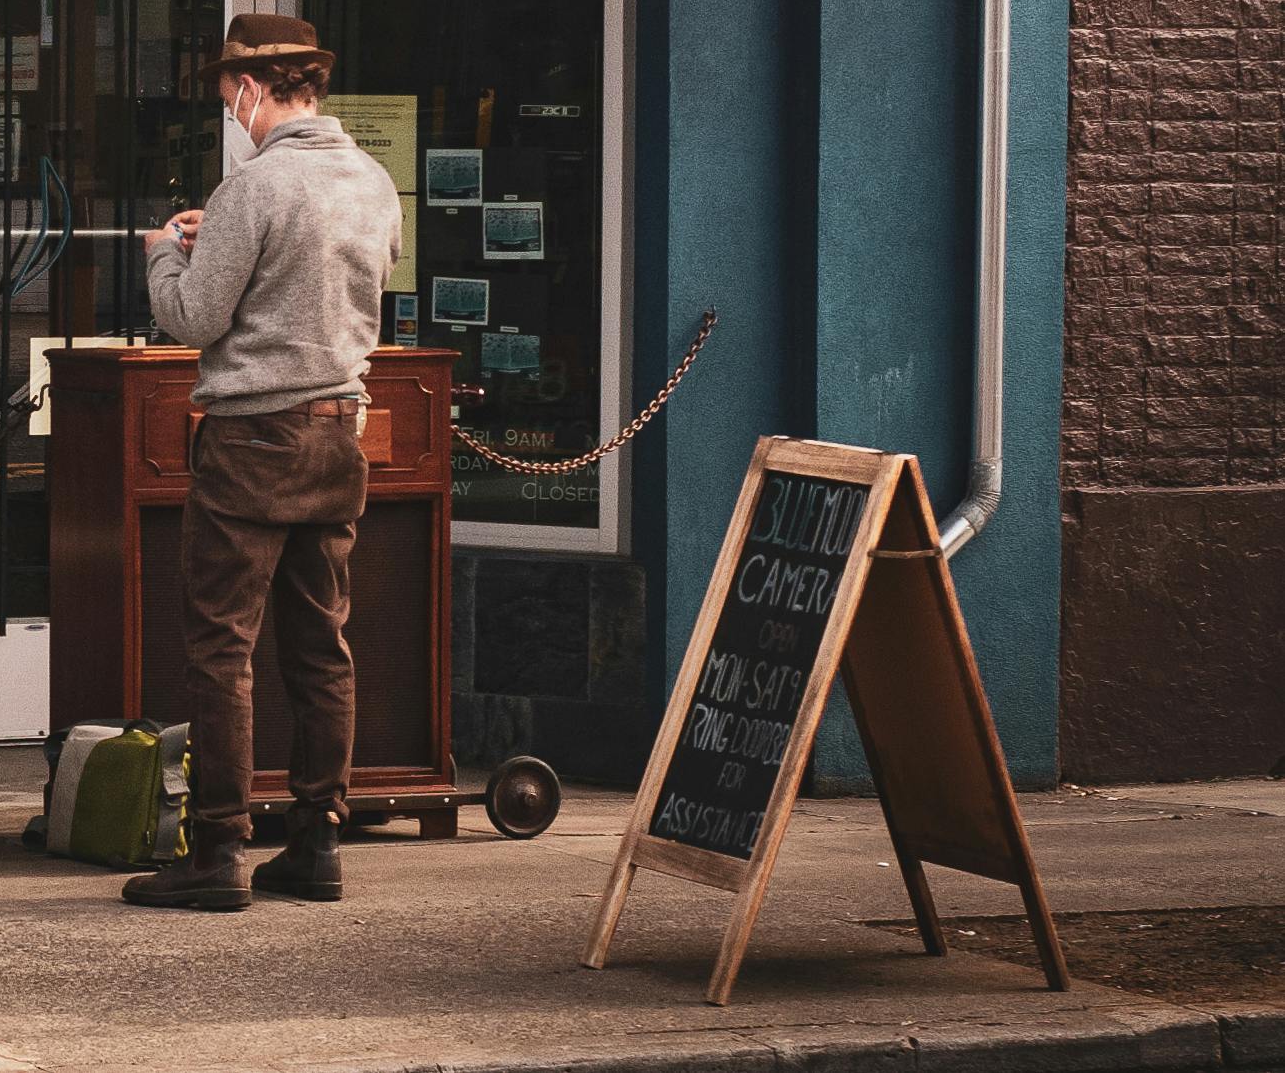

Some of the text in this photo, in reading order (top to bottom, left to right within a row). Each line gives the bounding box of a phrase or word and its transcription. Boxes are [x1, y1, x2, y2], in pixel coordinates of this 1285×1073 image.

[522, 481, 600, 503] CLOSED
[758, 619, 801, 653] OPEN
[683, 702, 735, 754] RING
[716, 760, 747, 790] FOR
[654, 791, 765, 853] ASSISTANCE
